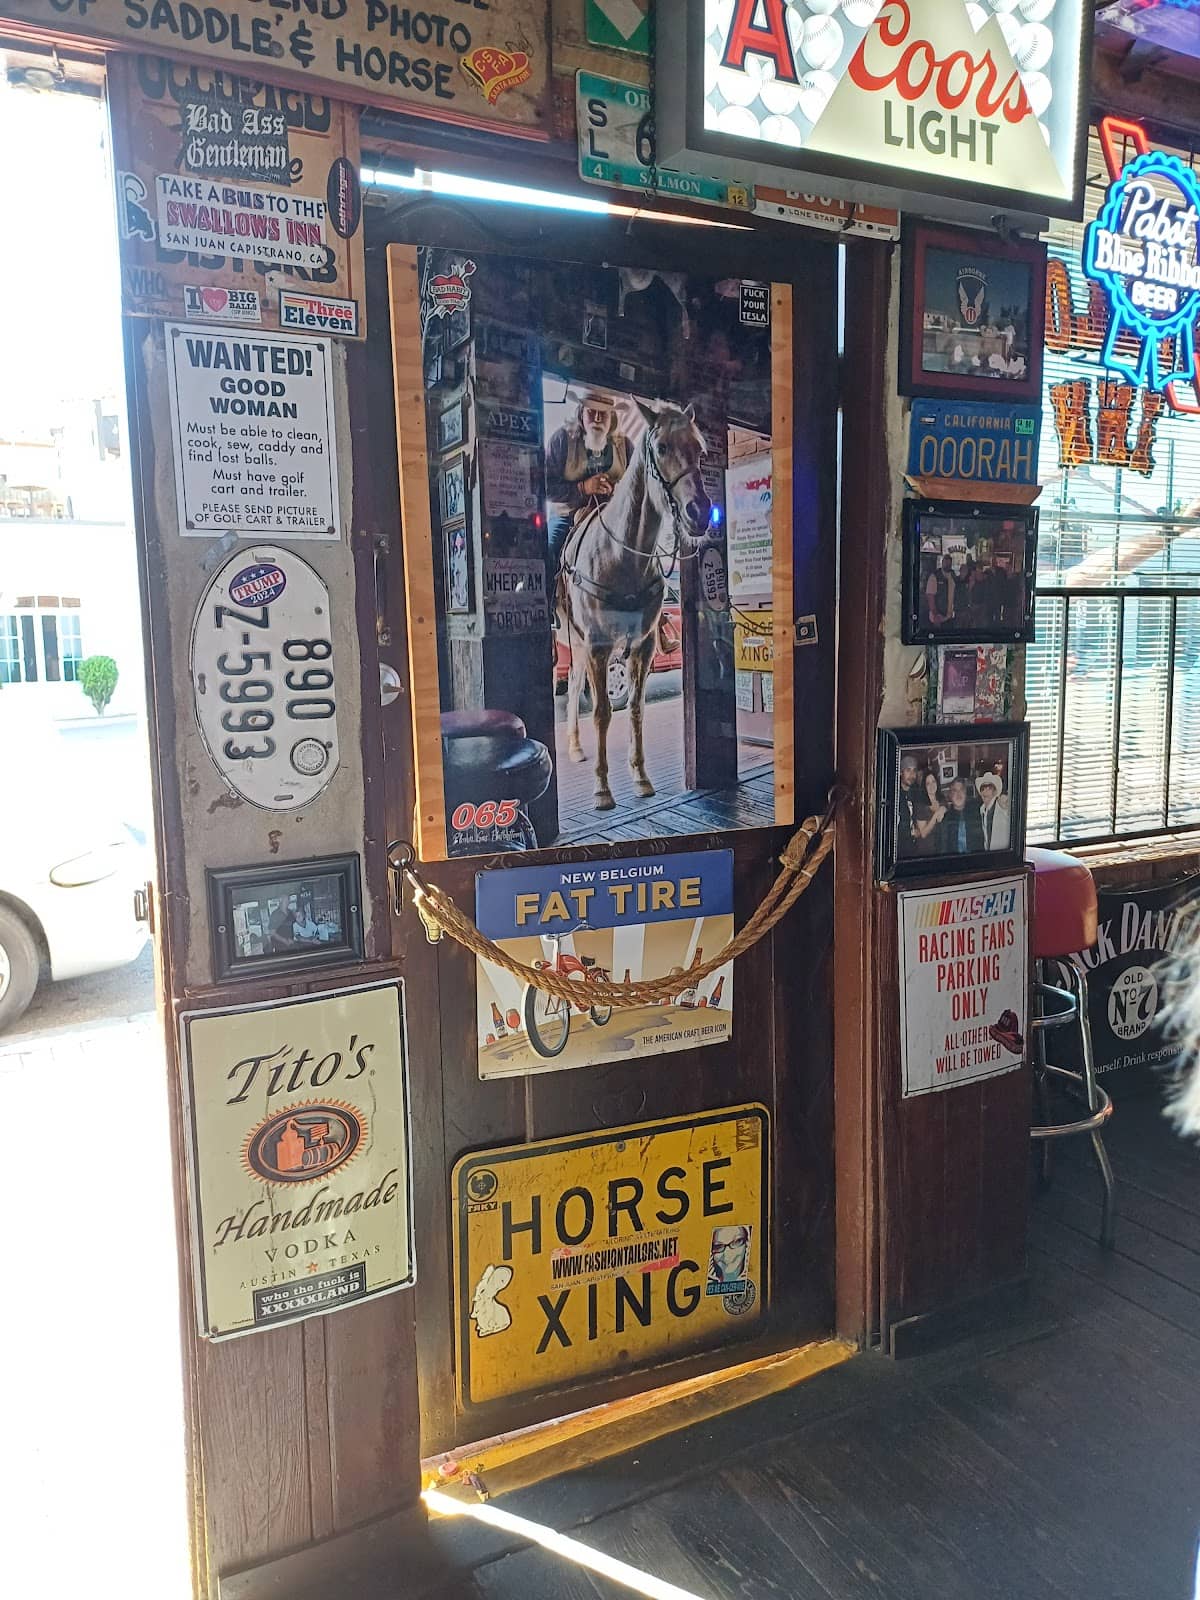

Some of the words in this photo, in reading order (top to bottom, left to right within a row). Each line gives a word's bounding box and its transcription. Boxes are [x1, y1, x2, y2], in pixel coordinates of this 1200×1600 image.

[365, 0, 472, 53] PHOTO
[290, 19, 316, 68] &
[336, 38, 456, 99] HORSE
[848, 0, 1032, 124] Coors
[186, 103, 233, 135] Bad
[241, 107, 286, 137] Ass
[884, 99, 1000, 165] LIGHT
[186, 136, 288, 170] Gentleman
[593, 164, 603, 178] 4
[159, 177, 203, 200] TAKE
[207, 185, 220, 203] A
[222, 188, 265, 210] BUS
[266, 194, 288, 214] TO
[292, 199, 325, 219] THE
[732, 194, 744, 205] 12
[1124, 181, 1199, 246] Pabst
[167, 200, 280, 241] SWALLOWS
[285, 218, 322, 247] INN
[167, 232, 190, 246] SAN
[195, 236, 225, 250] JUAN
[230, 242, 306, 263] CAPISTRANO,
[310, 253, 324, 264] CA
[1095, 230, 1144, 276] Blue
[228, 290, 257, 303] BIG
[744, 288, 765, 299] FUCK
[744, 300, 765, 310] YOUR
[1131, 281, 1178, 312] BEER
[284, 305, 353, 331] Eleven
[304, 300, 353, 319] Three
[742, 311, 767, 322] TESLA
[187, 339, 313, 377] WANTED!
[220, 377, 286, 397] GOOD
[209, 397, 298, 419] WOMAN
[486, 411, 531, 431] APEX
[944, 414, 1011, 430] CALIFORNIA
[187, 422, 216, 434] Must
[220, 424, 236, 436] be
[240, 425, 268, 438] able
[271, 428, 283, 438] to
[287, 429, 323, 442] clean,
[187, 437, 222, 450] cook,
[227, 442, 253, 452] sew,
[258, 440, 296, 456] caddy
[300, 444, 323, 455] and
[188, 451, 213, 462] find
[218, 450, 239, 464] lost
[244, 454, 277, 466] balls.
[211, 484, 235, 494] cart
[240, 484, 264, 496] and
[269, 485, 307, 497] trailer.
[213, 469, 241, 481] Must
[247, 470, 276, 482] have
[281, 472, 305, 486] golf
[195, 513, 210, 523] OF
[214, 514, 243, 524] GOLF
[246, 515, 272, 525] CART
[276, 516, 284, 525] &
[287, 516, 326, 527] TRAILER
[202, 503, 240, 514] PLEASE
[244, 505, 273, 515] SEND
[277, 506, 318, 516] PICTURE
[234, 572, 280, 599] TRUMP
[250, 588, 276, 604] 2024
[282, 639, 336, 720] 890
[452, 800, 519, 831] 065
[560, 872, 596, 885] NEW
[600, 865, 664, 881] BELGIUM
[515, 887, 596, 926] FAT
[608, 877, 702, 915] TIRE
[946, 888, 1016, 924] NASCAR
[919, 927, 975, 963] RACING
[982, 919, 1014, 952] FANS
[937, 954, 1000, 992] PARKING
[1123, 972, 1144, 986] OLD
[952, 987, 989, 1022] ONLY
[643, 1036, 654, 1045] THE
[655, 1031, 683, 1043] AMERICAN
[684, 1027, 700, 1038] CRAFT
[701, 1025, 714, 1036] BEER
[715, 1023, 727, 1033] ICON
[944, 1031, 959, 1052] ALL
[1117, 1021, 1146, 1037] BRAND
[226, 1034, 375, 1104] Tito's
[936, 1053, 957, 1074] WILL
[960, 1051, 971, 1068] BE
[974, 1043, 1001, 1065] TOWED
[1094, 1060, 1122, 1076] ourself.
[1123, 1053, 1146, 1069] Drink
[1147, 1046, 1183, 1061] respons
[213, 1168, 399, 1248] Handmade
[501, 1157, 734, 1260] HORSE
[265, 1229, 357, 1263] VODKA
[240, 1268, 297, 1290] AUSTIN
[329, 1244, 381, 1267] TEXAS
[261, 1291, 290, 1304] who
[317, 1277, 346, 1290] fuck
[349, 1270, 360, 1282] is
[535, 1260, 701, 1355] XING
